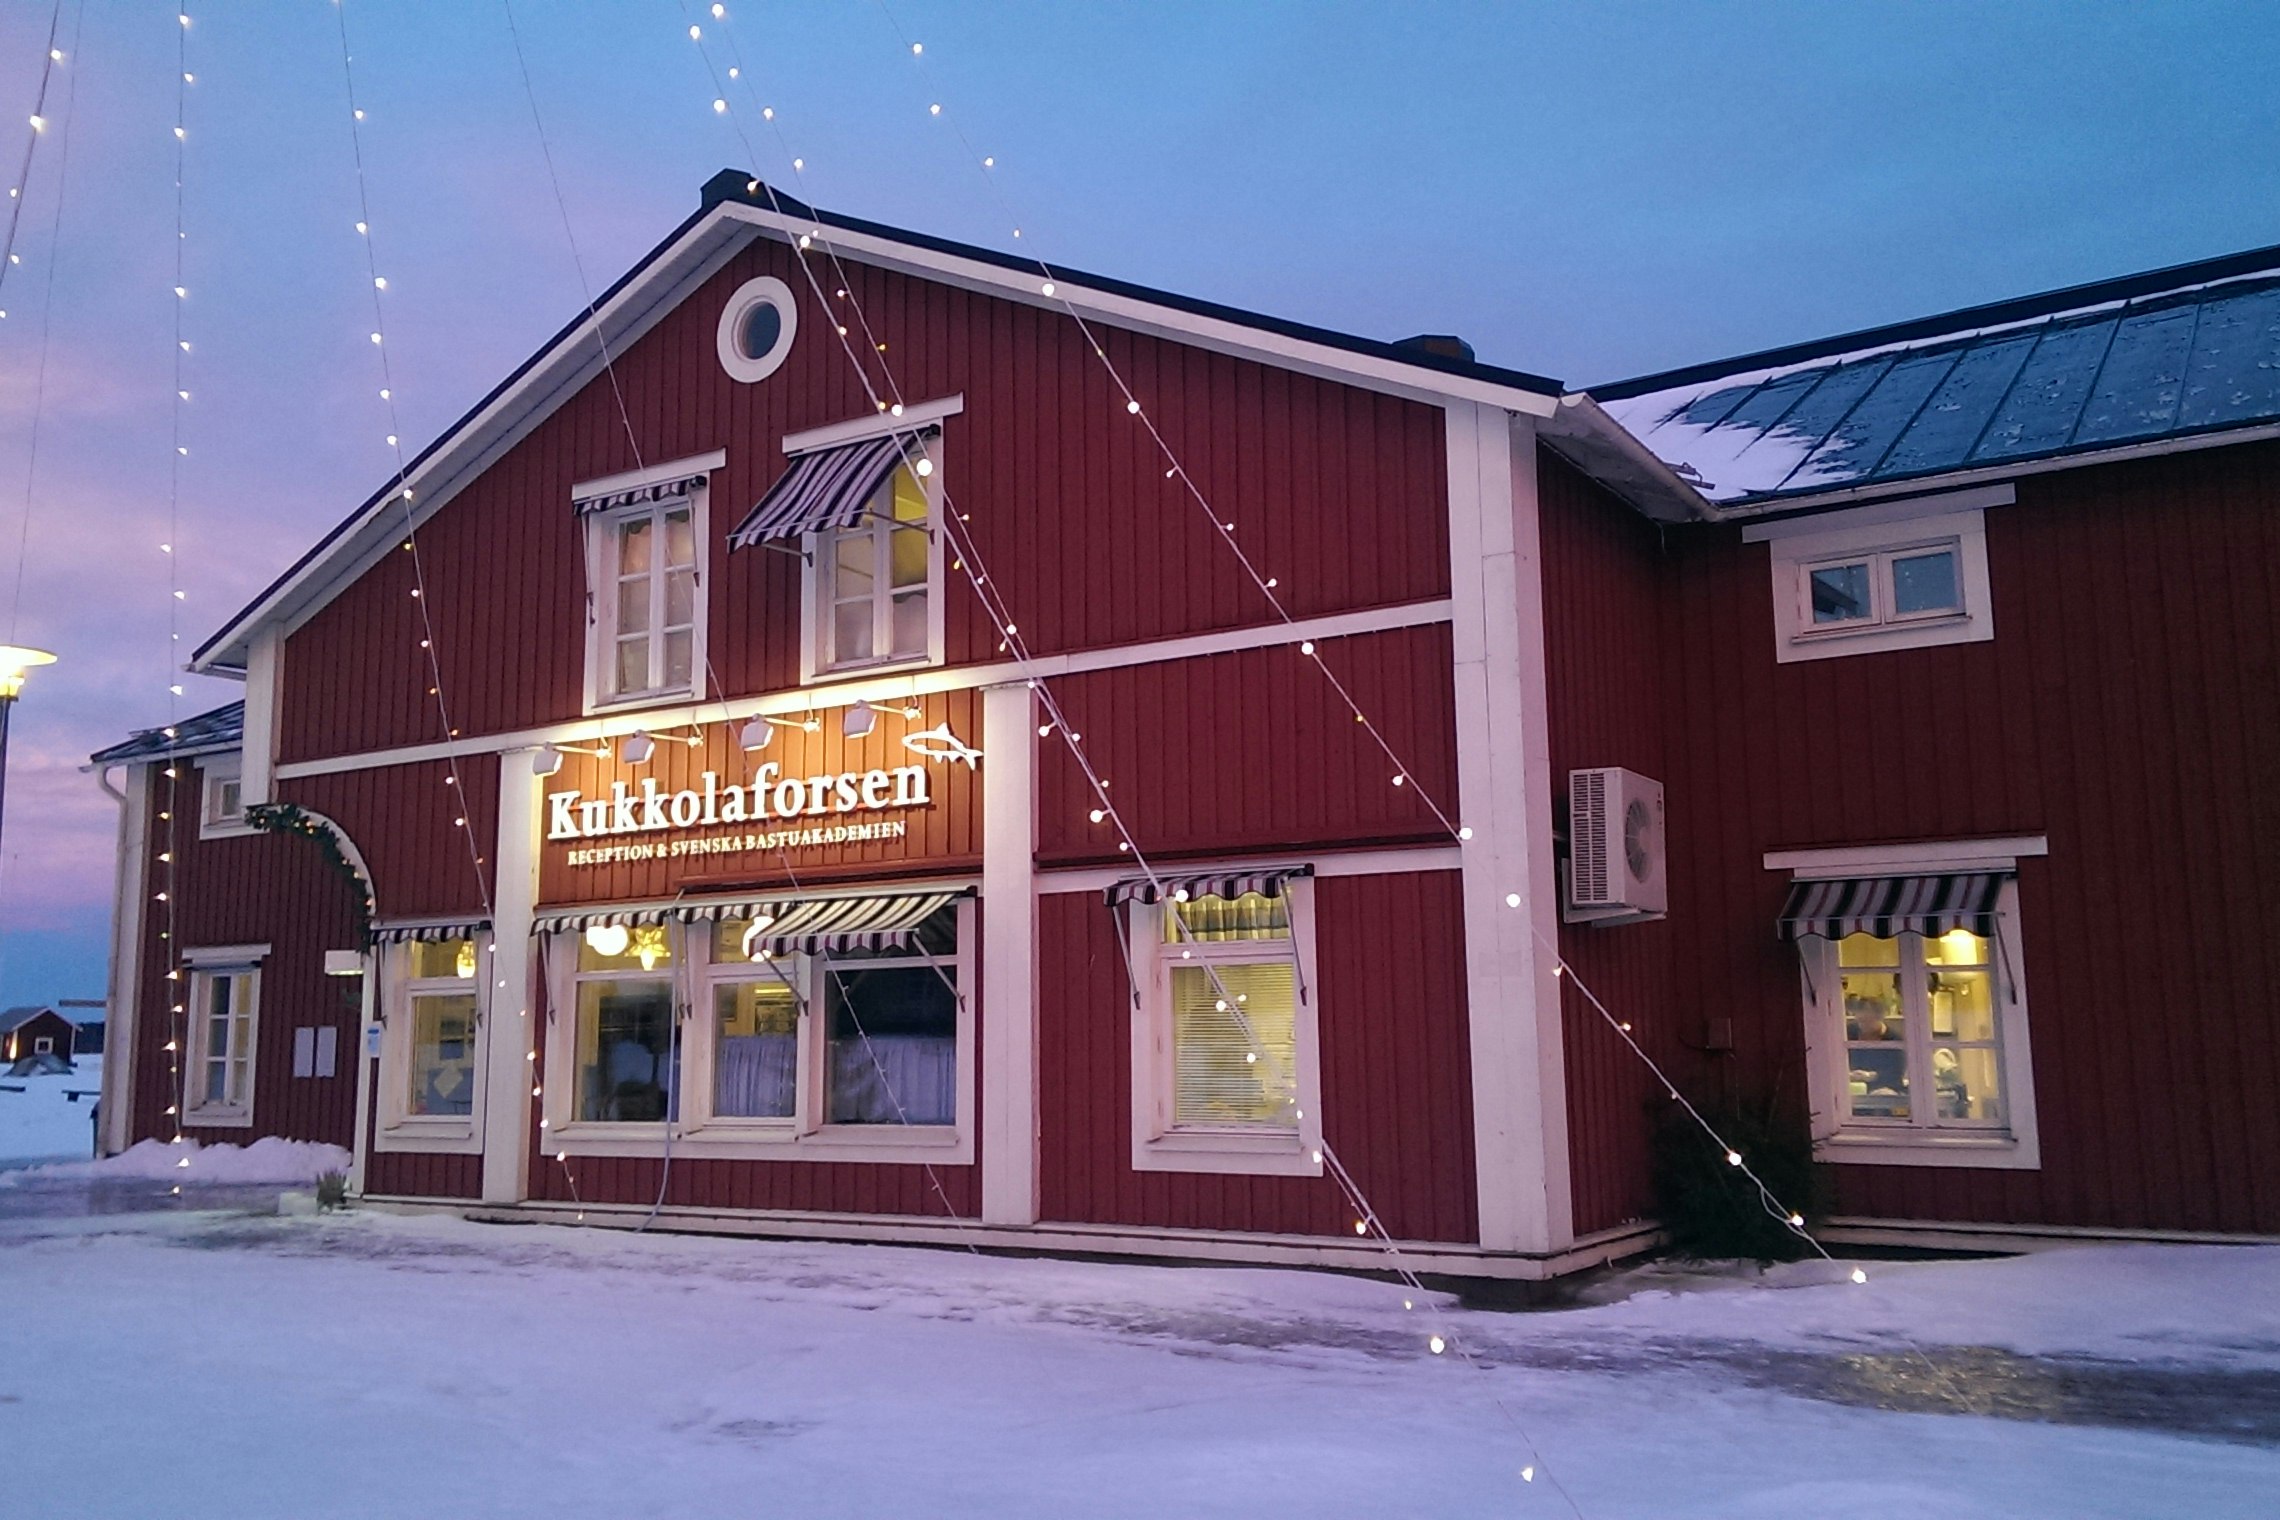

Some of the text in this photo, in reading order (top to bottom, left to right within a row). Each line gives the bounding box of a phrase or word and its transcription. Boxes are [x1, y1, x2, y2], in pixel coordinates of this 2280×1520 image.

[547, 762, 930, 839] Kukkolaforsen
[568, 820, 906, 865] RECEPTION & SVENSKA BASTUAKADEMIEN
